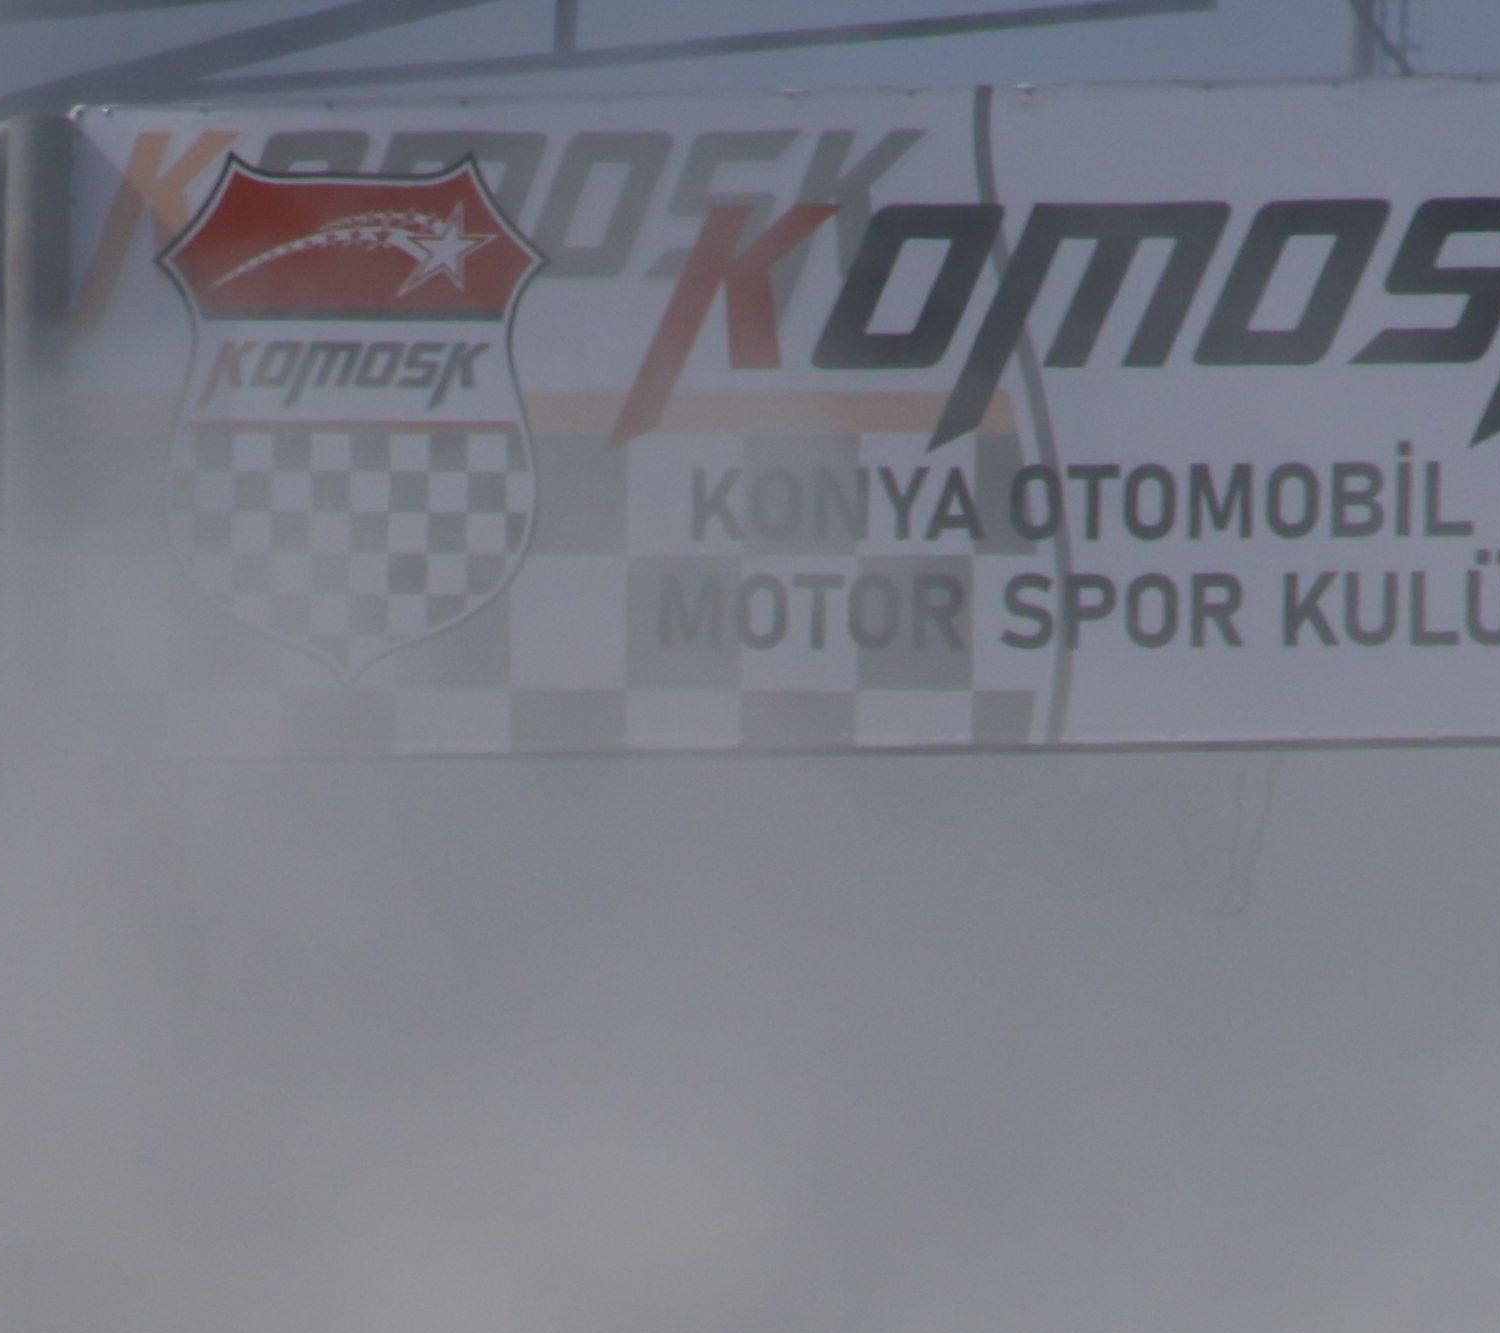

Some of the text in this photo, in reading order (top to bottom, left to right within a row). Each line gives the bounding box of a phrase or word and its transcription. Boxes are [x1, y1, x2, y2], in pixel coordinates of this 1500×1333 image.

[690, 465, 986, 541] KONYA
[1008, 439, 1474, 542] OTOMOBİL
[658, 572, 968, 651] MOTOR
[1000, 570, 1244, 650] SPOR
